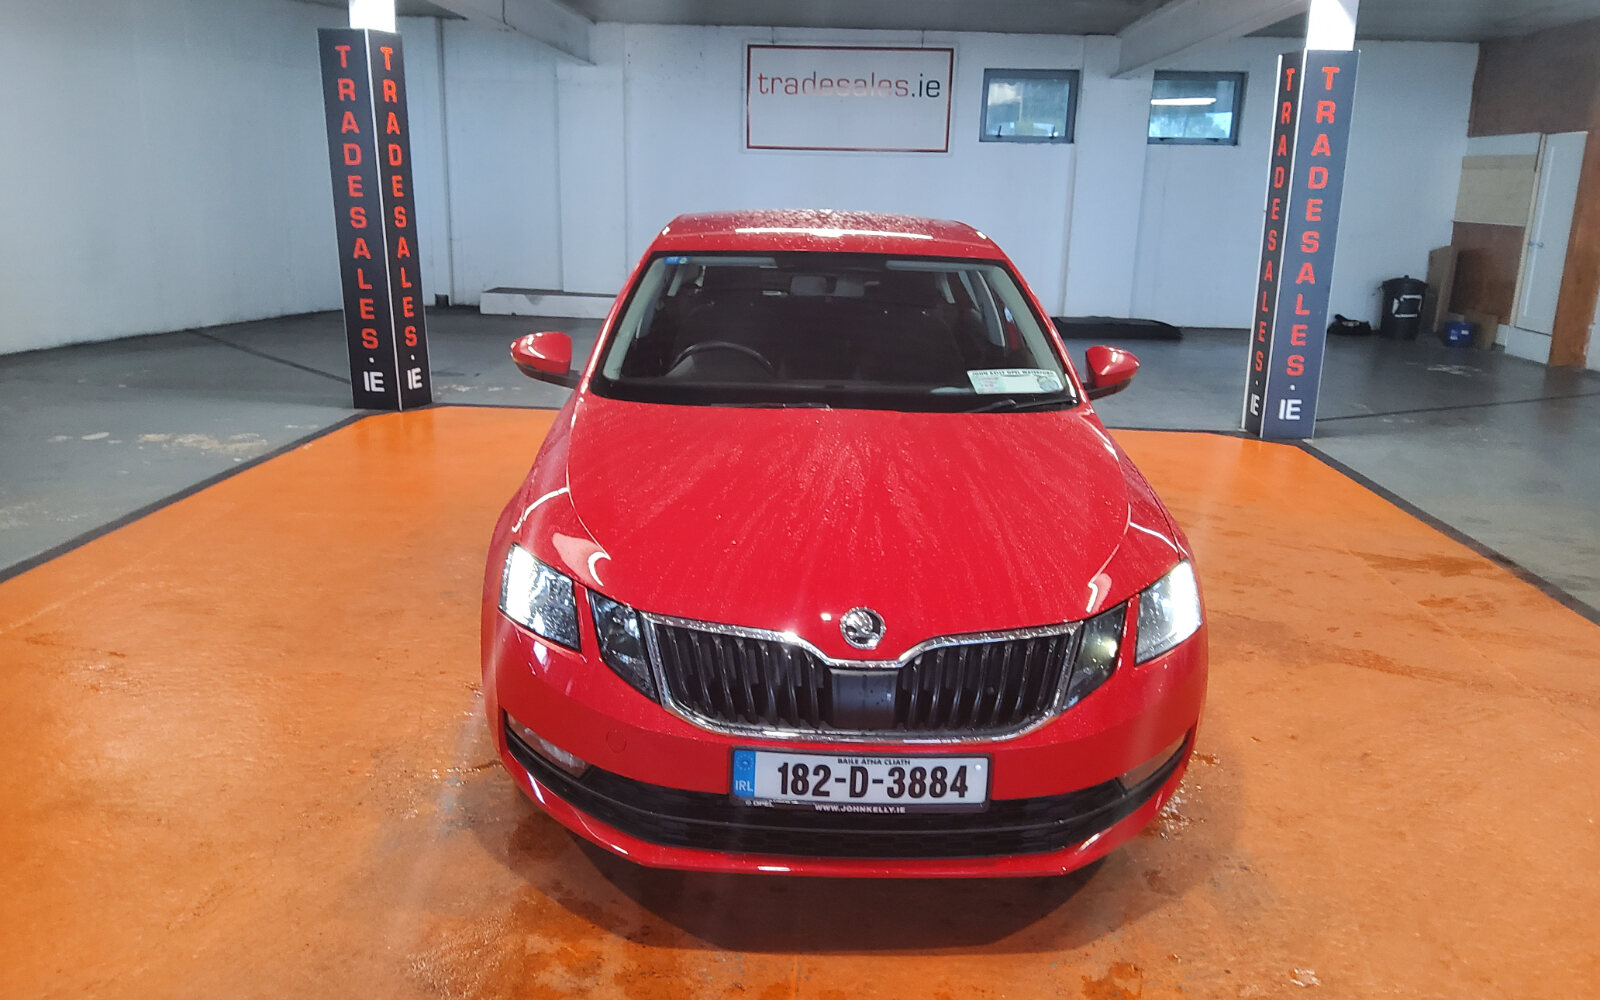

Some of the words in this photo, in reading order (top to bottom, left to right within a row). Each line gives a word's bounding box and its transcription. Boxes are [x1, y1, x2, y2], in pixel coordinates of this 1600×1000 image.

[757, 71, 941, 98] tradesales.ie
[735, 779, 754, 792] IRL
[777, 762, 969, 799] 182-D-3884
[814, 803, 906, 814] WWW.JOHNKELLY.IE
